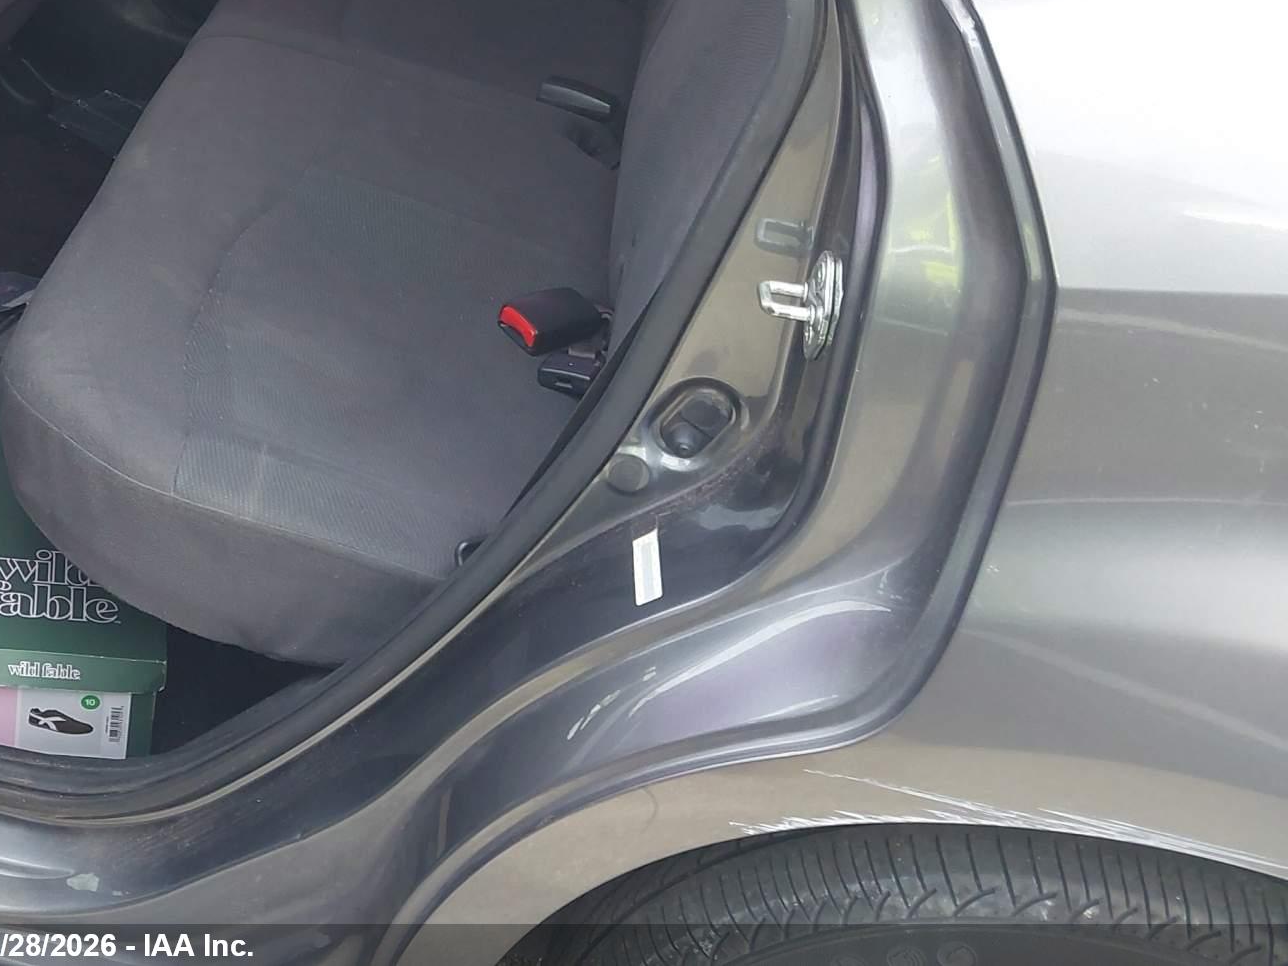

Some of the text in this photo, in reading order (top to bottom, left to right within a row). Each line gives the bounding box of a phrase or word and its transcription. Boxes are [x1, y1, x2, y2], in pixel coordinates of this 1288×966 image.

[8, 661, 81, 680] wild fable
[85, 698, 96, 706] 10
